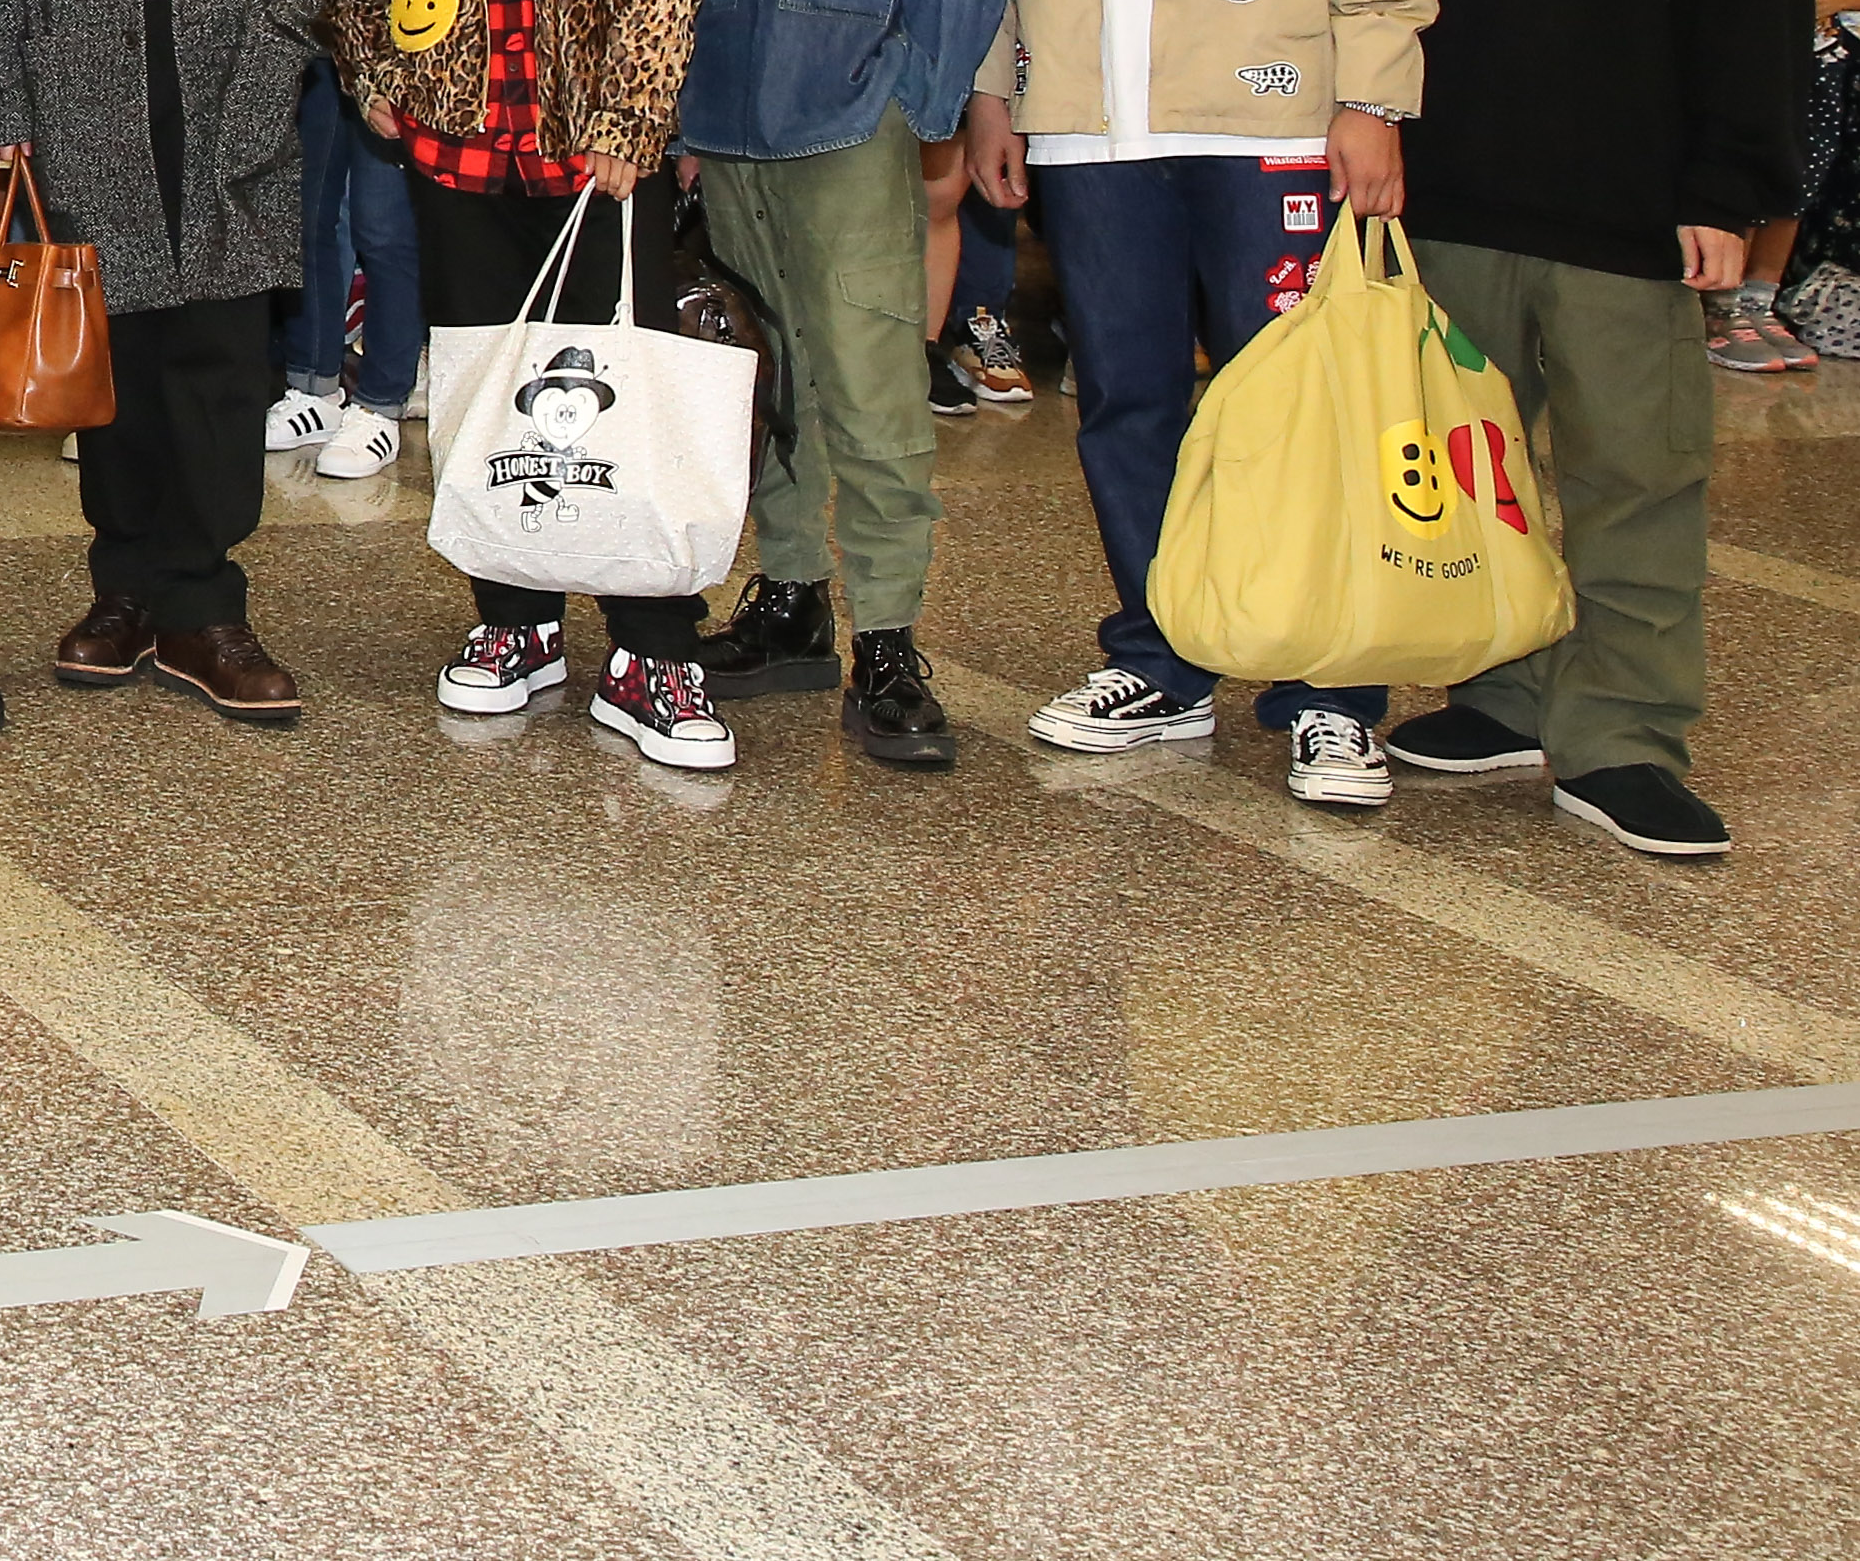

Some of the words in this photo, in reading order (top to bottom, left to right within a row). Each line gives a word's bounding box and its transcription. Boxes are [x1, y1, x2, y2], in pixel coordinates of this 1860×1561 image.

[1287, 200, 1316, 214] W.Y.
[494, 455, 561, 483] HONEST
[566, 464, 607, 484] BOY
[1381, 544, 1434, 578] WE'RE
[1442, 553, 1480, 579] GOOD!
